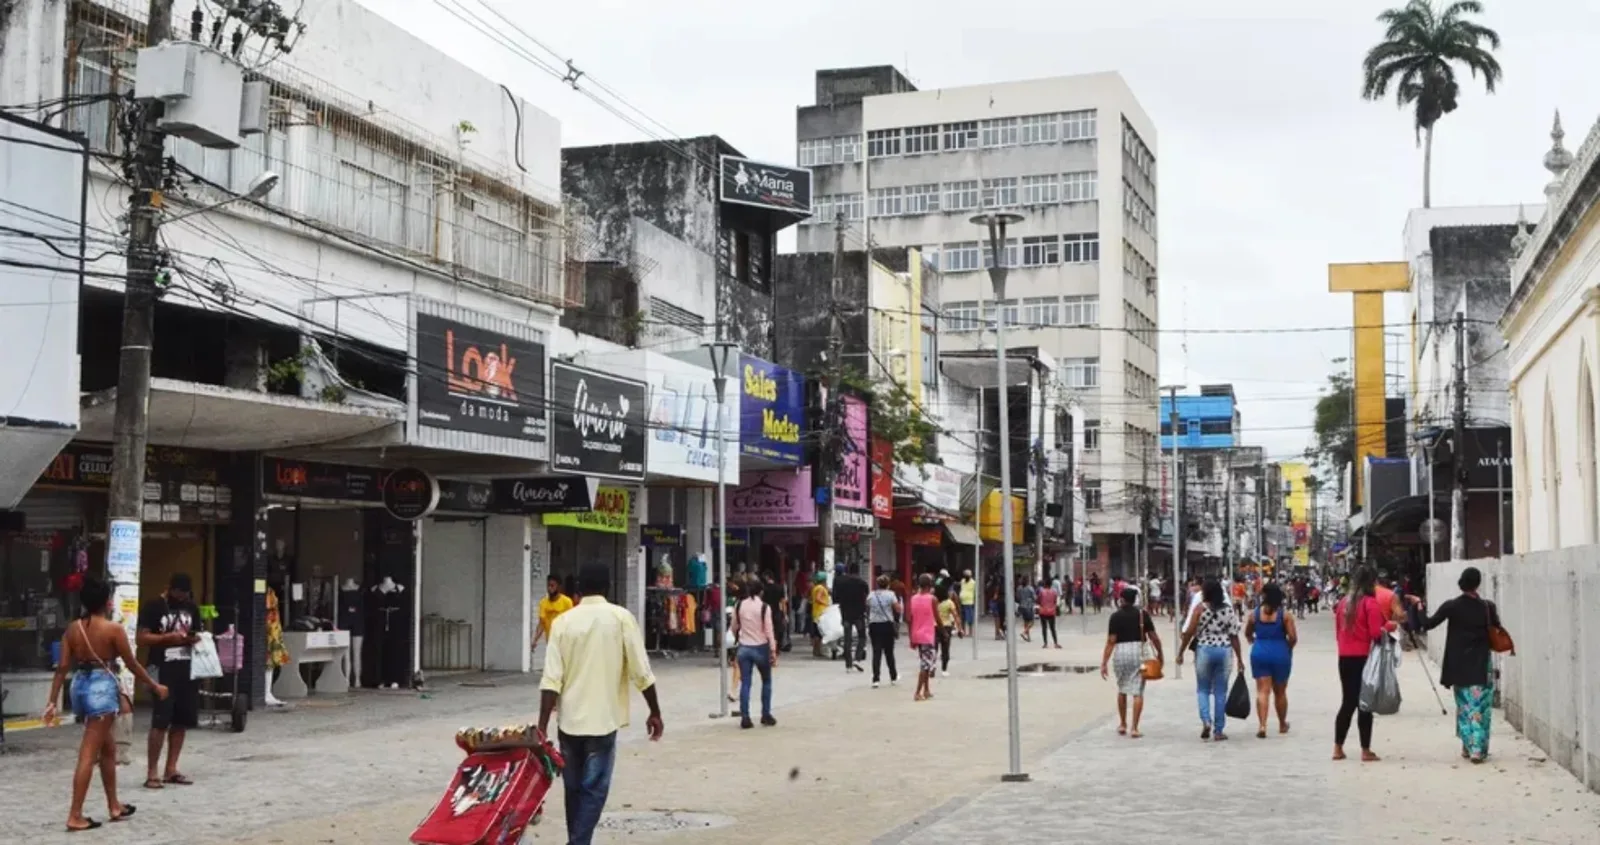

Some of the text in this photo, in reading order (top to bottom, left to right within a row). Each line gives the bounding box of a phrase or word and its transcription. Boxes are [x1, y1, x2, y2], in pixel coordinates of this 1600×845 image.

[446, 328, 518, 401] Look
[744, 363, 777, 402] Sales
[460, 400, 475, 418] da
[479, 404, 509, 422] moda
[762, 407, 800, 443] Modas
[1477, 457, 1513, 467] ATACA
[512, 480, 569, 502] Amora
